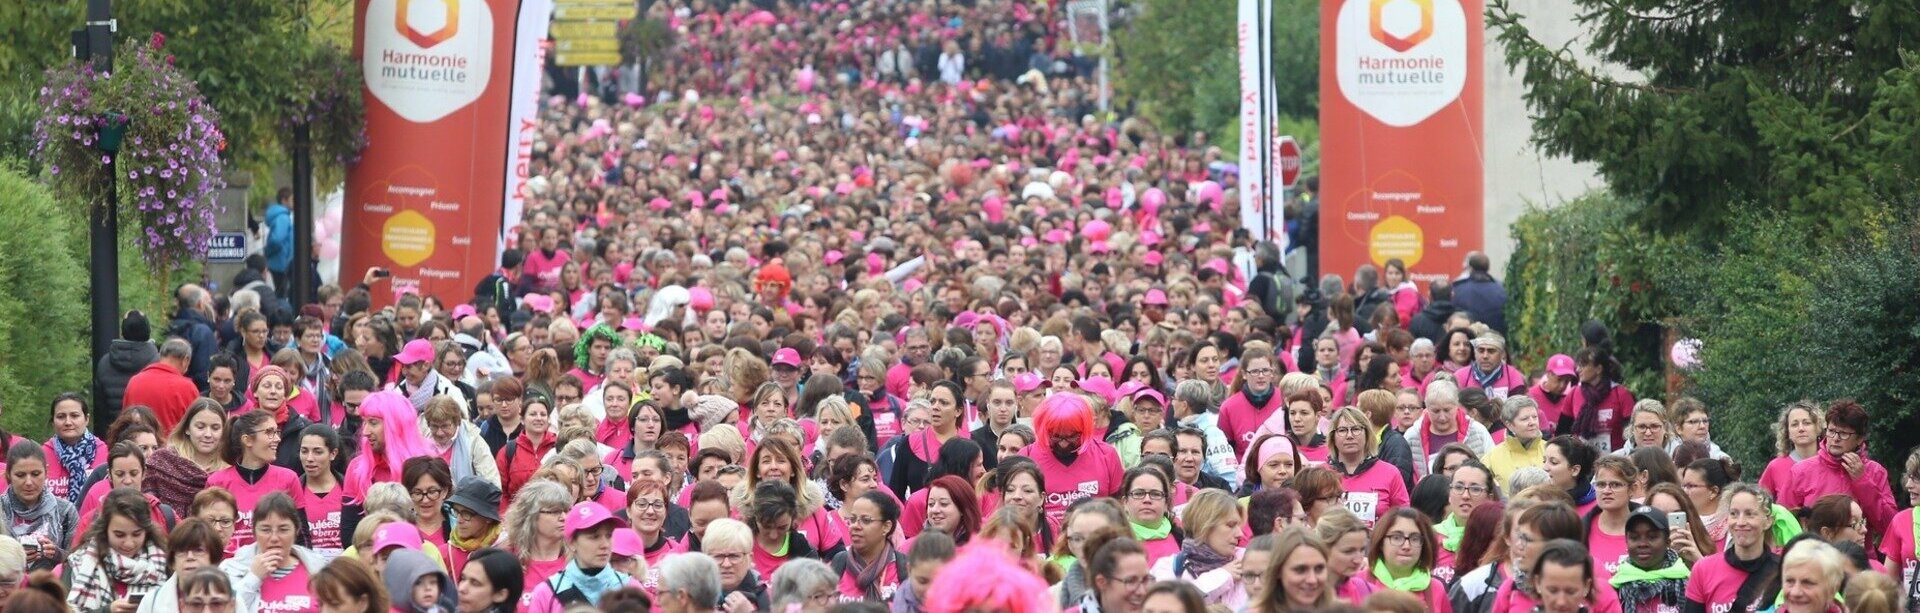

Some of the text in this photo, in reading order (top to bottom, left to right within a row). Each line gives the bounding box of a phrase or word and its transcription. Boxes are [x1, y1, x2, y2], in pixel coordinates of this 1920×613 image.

[383, 49, 467, 69] Harmonie
[1359, 54, 1445, 70] Harmonie
[382, 65, 467, 83] mutuelle
[1359, 70, 1445, 84] mutuelle
[387, 185, 436, 197] Accompagner
[318, 529, 340, 539] berry
